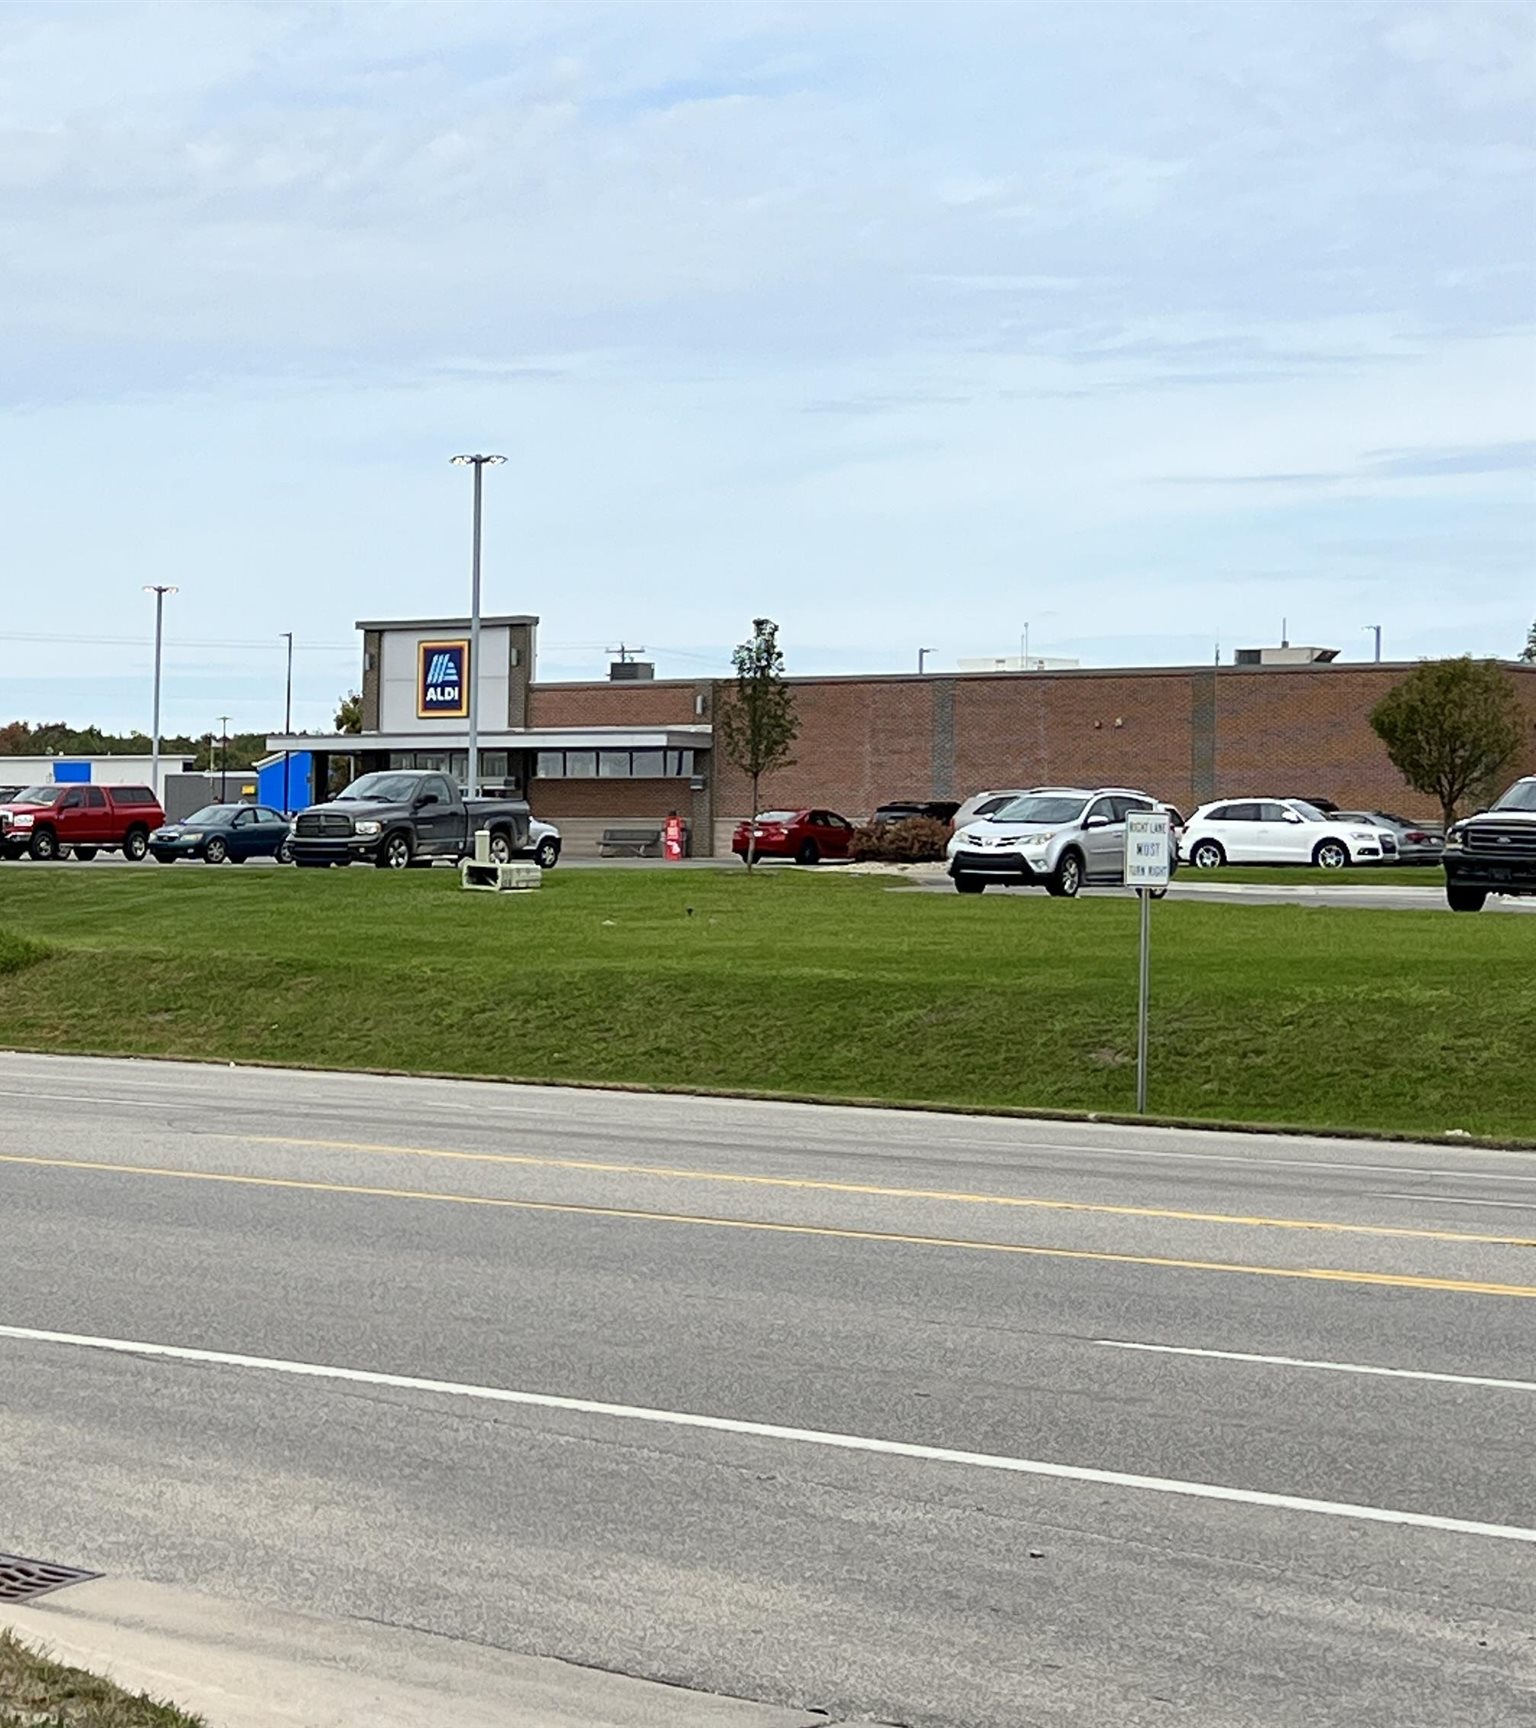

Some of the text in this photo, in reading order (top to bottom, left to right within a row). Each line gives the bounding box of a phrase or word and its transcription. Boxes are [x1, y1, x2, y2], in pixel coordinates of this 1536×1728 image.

[425, 686, 459, 702] ALDI
[1129, 822, 1167, 834] RIGHT LANE
[1136, 842, 1161, 857] MUST
[1129, 865, 1167, 877] TURN RIGHT
